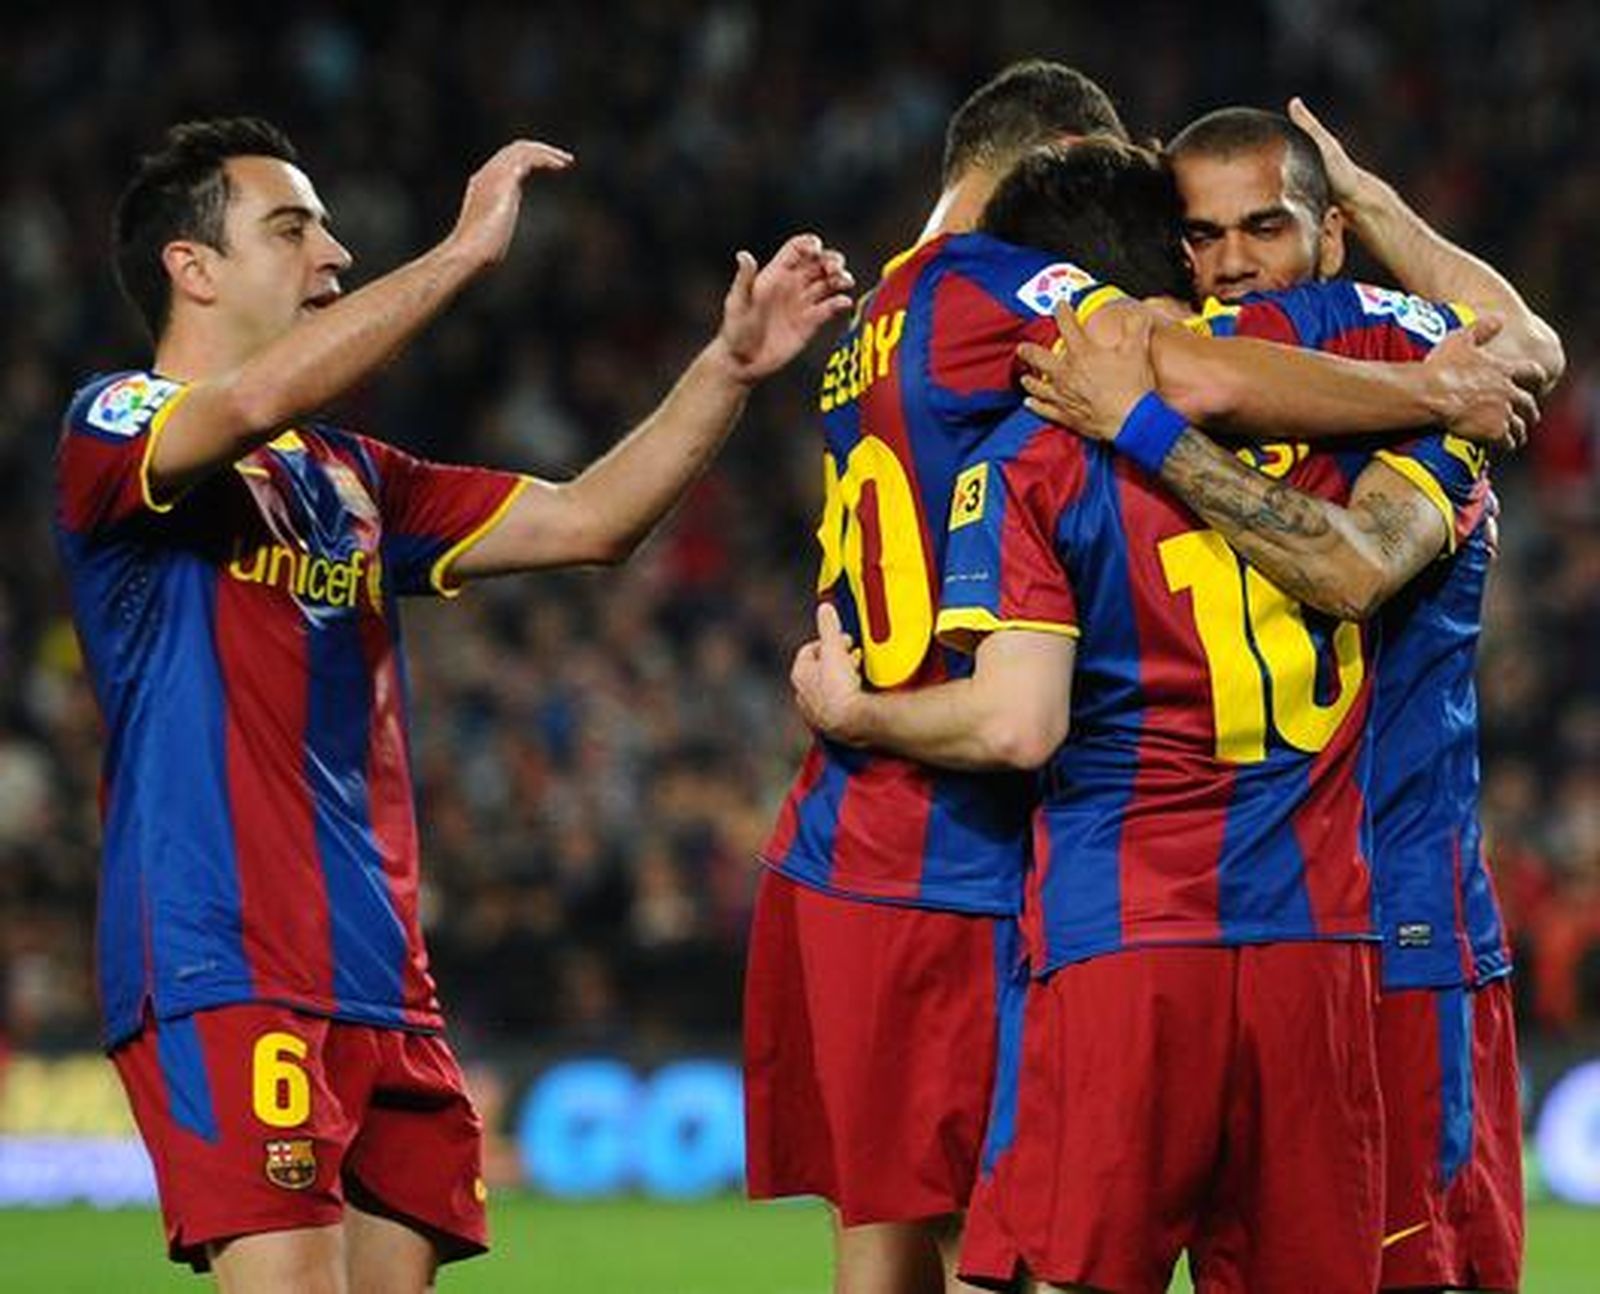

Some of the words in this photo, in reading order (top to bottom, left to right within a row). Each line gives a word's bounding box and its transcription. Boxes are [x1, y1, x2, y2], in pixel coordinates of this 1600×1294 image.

[229, 544, 365, 607] unicef
[1158, 530, 1364, 763] 10
[253, 1031, 310, 1128] 6
